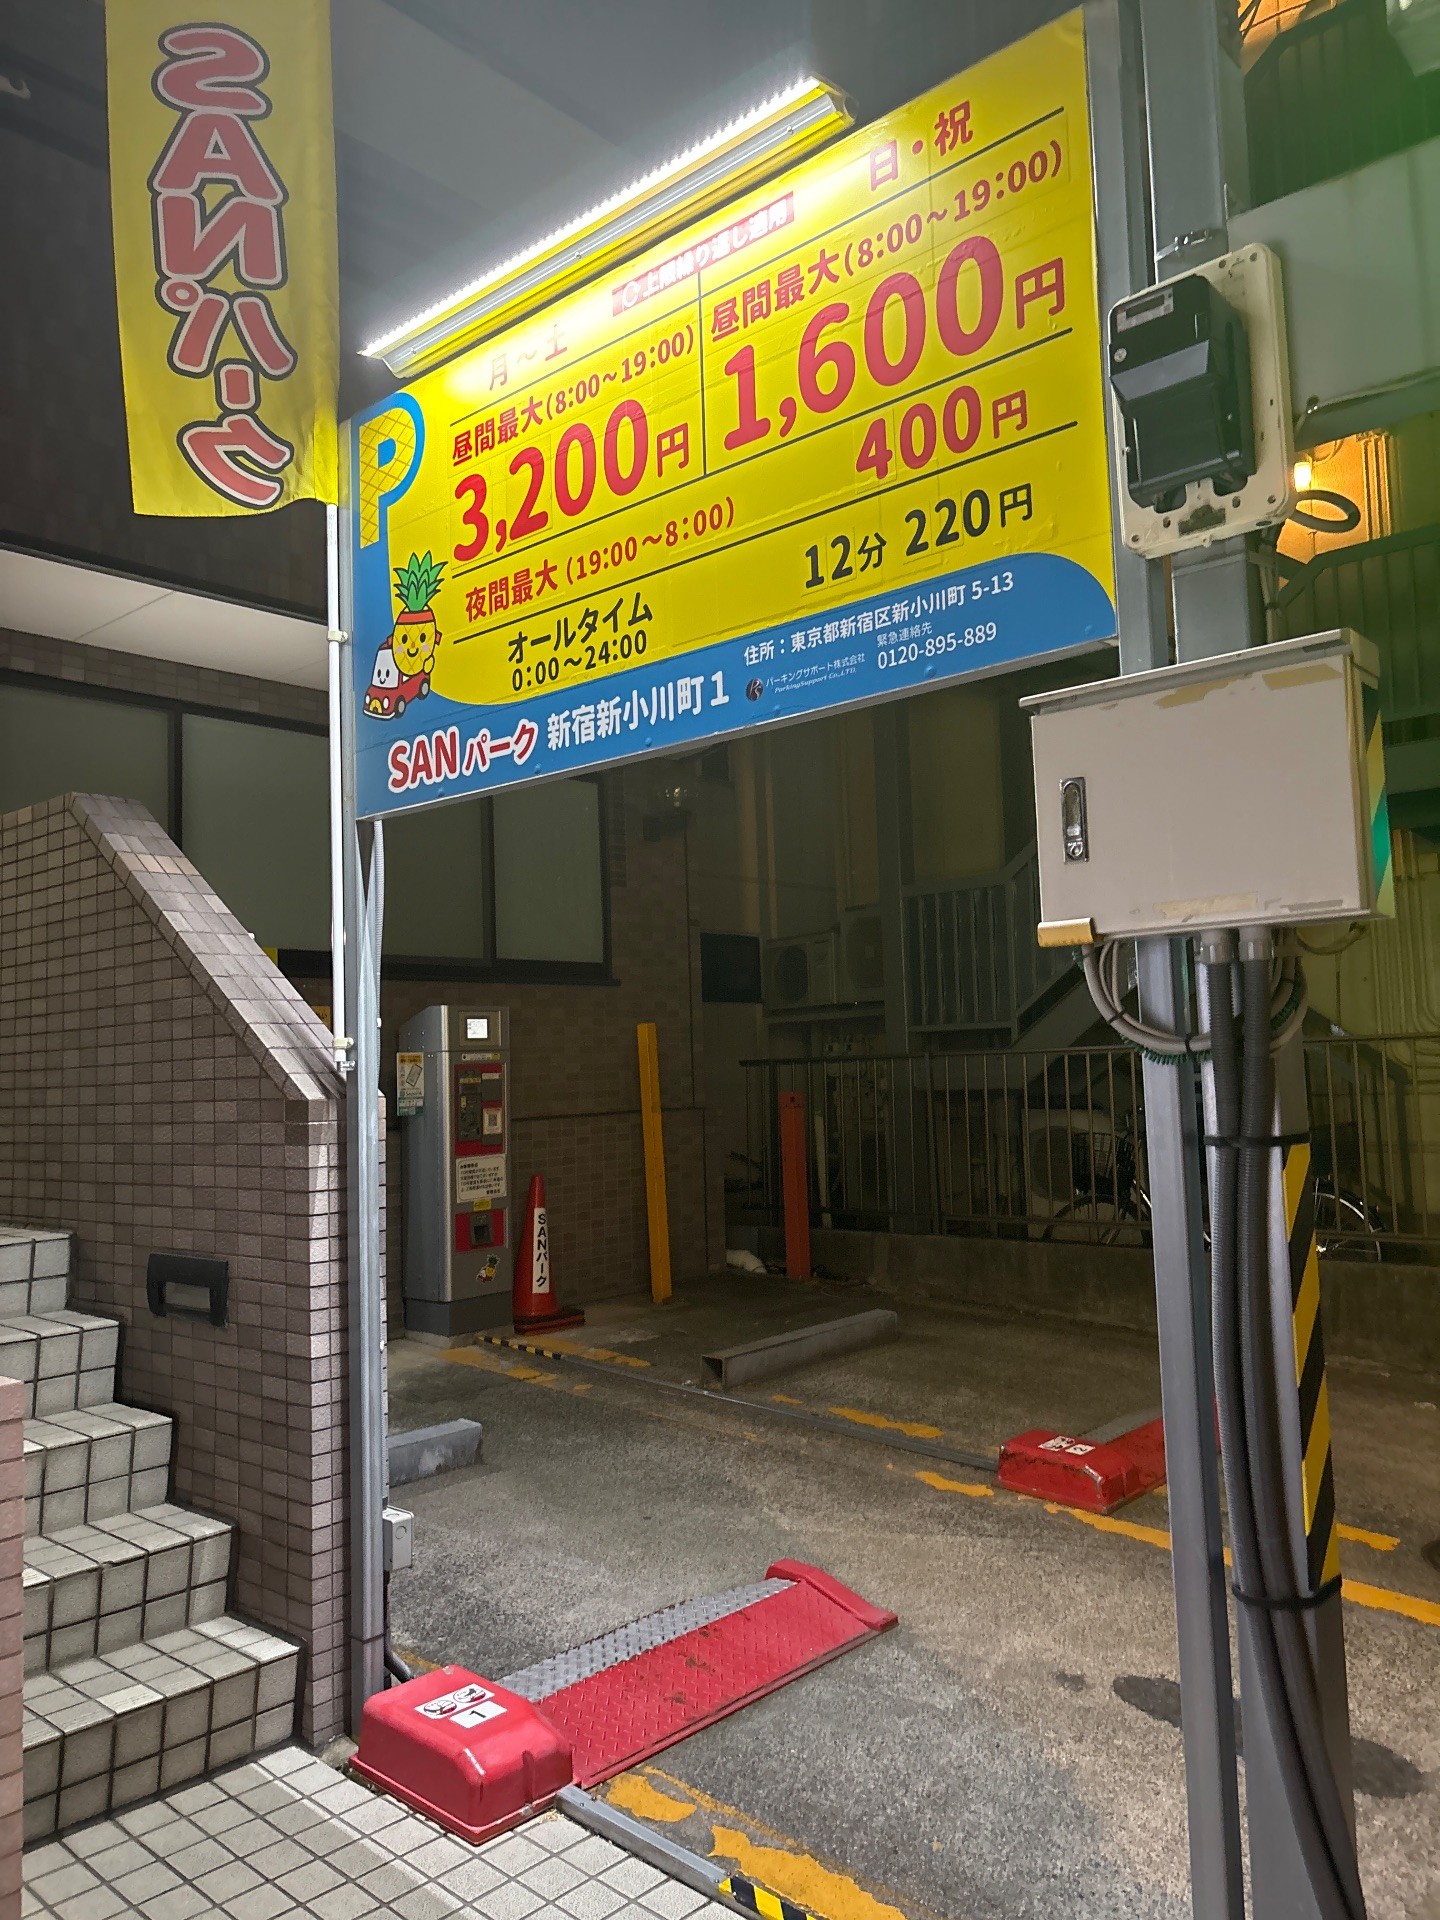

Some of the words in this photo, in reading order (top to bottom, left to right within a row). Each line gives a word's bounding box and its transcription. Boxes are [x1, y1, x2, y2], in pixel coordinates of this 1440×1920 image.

[869, 100, 974, 191] 日・祝
[723, 235, 1065, 451] 1,600円
[855, 385, 1028, 479] 400円
[453, 399, 689, 561] 3,200円
[805, 532, 887, 588] 12分
[904, 482, 1034, 557] 220円
[971, 571, 1014, 600] 5-13
[507, 592, 653, 664] オールタイム
[876, 621, 933, 648] 緊急連絡先
[877, 622, 997, 670] 0120-895-889
[469, 1710, 487, 1719] 1
